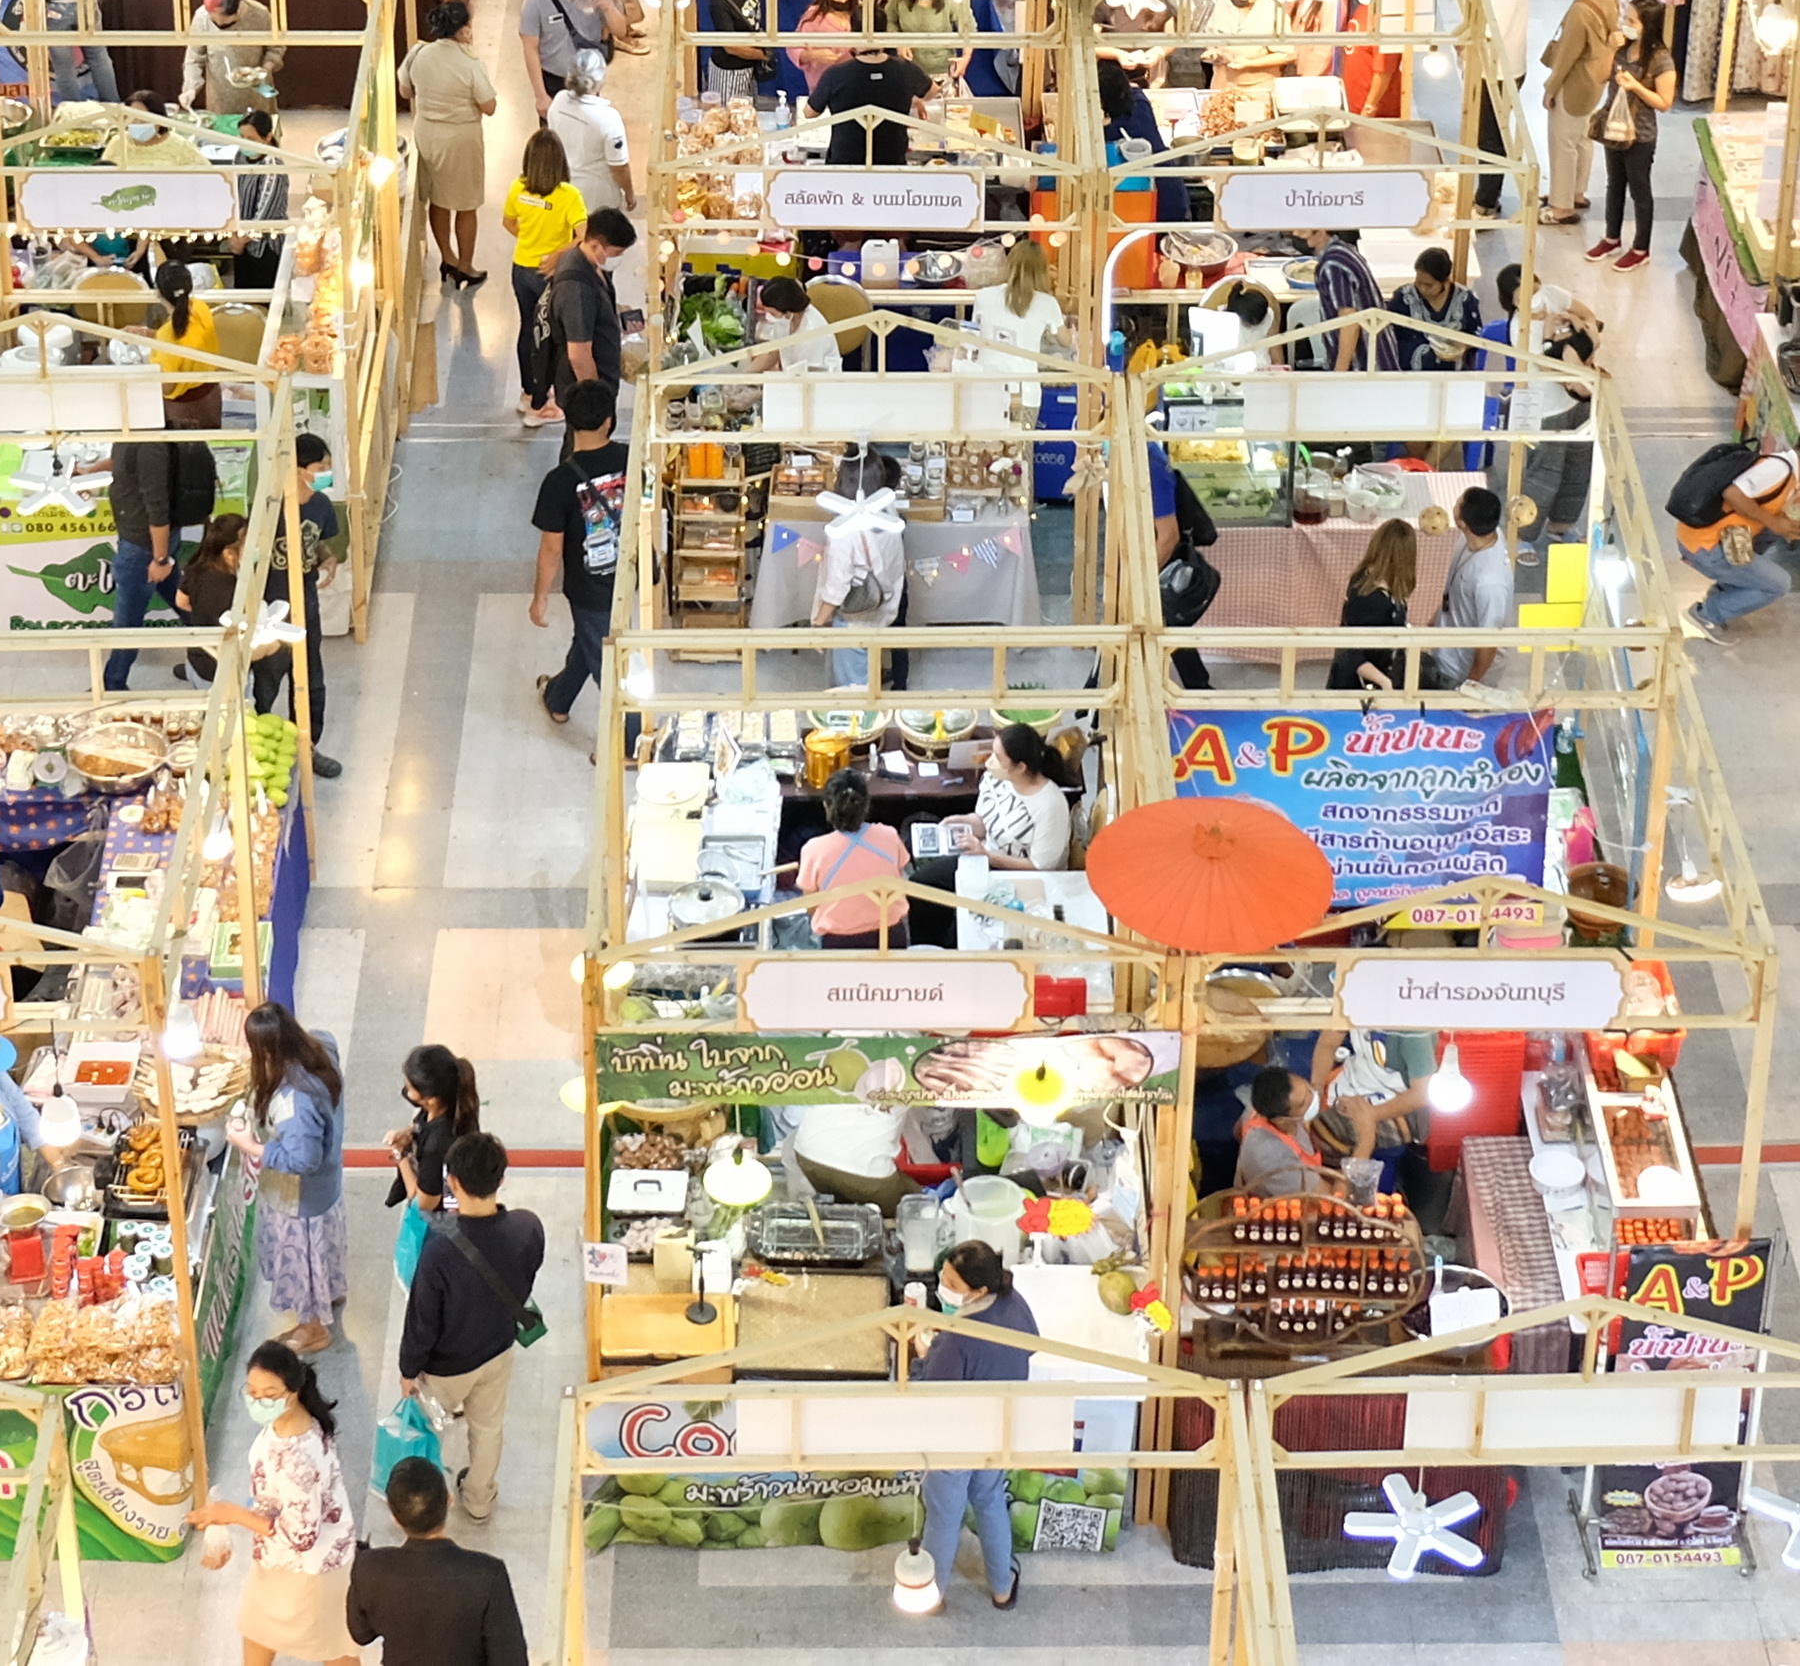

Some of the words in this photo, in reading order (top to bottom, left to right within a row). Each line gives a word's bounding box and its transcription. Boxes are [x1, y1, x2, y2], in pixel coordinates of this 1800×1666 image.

[852, 192, 865, 206] &
[25, 522, 55, 534] 080
[1343, 713, 1486, 758] น้ำปานะ
[1411, 905, 1538, 928] 087-014493
[1398, 977, 1567, 1006] น้ำสำรองจันทบุรี
[668, 1059, 840, 1100] มะพร้าวอ่อน
[1615, 1550, 1723, 1566] 087-0154493
